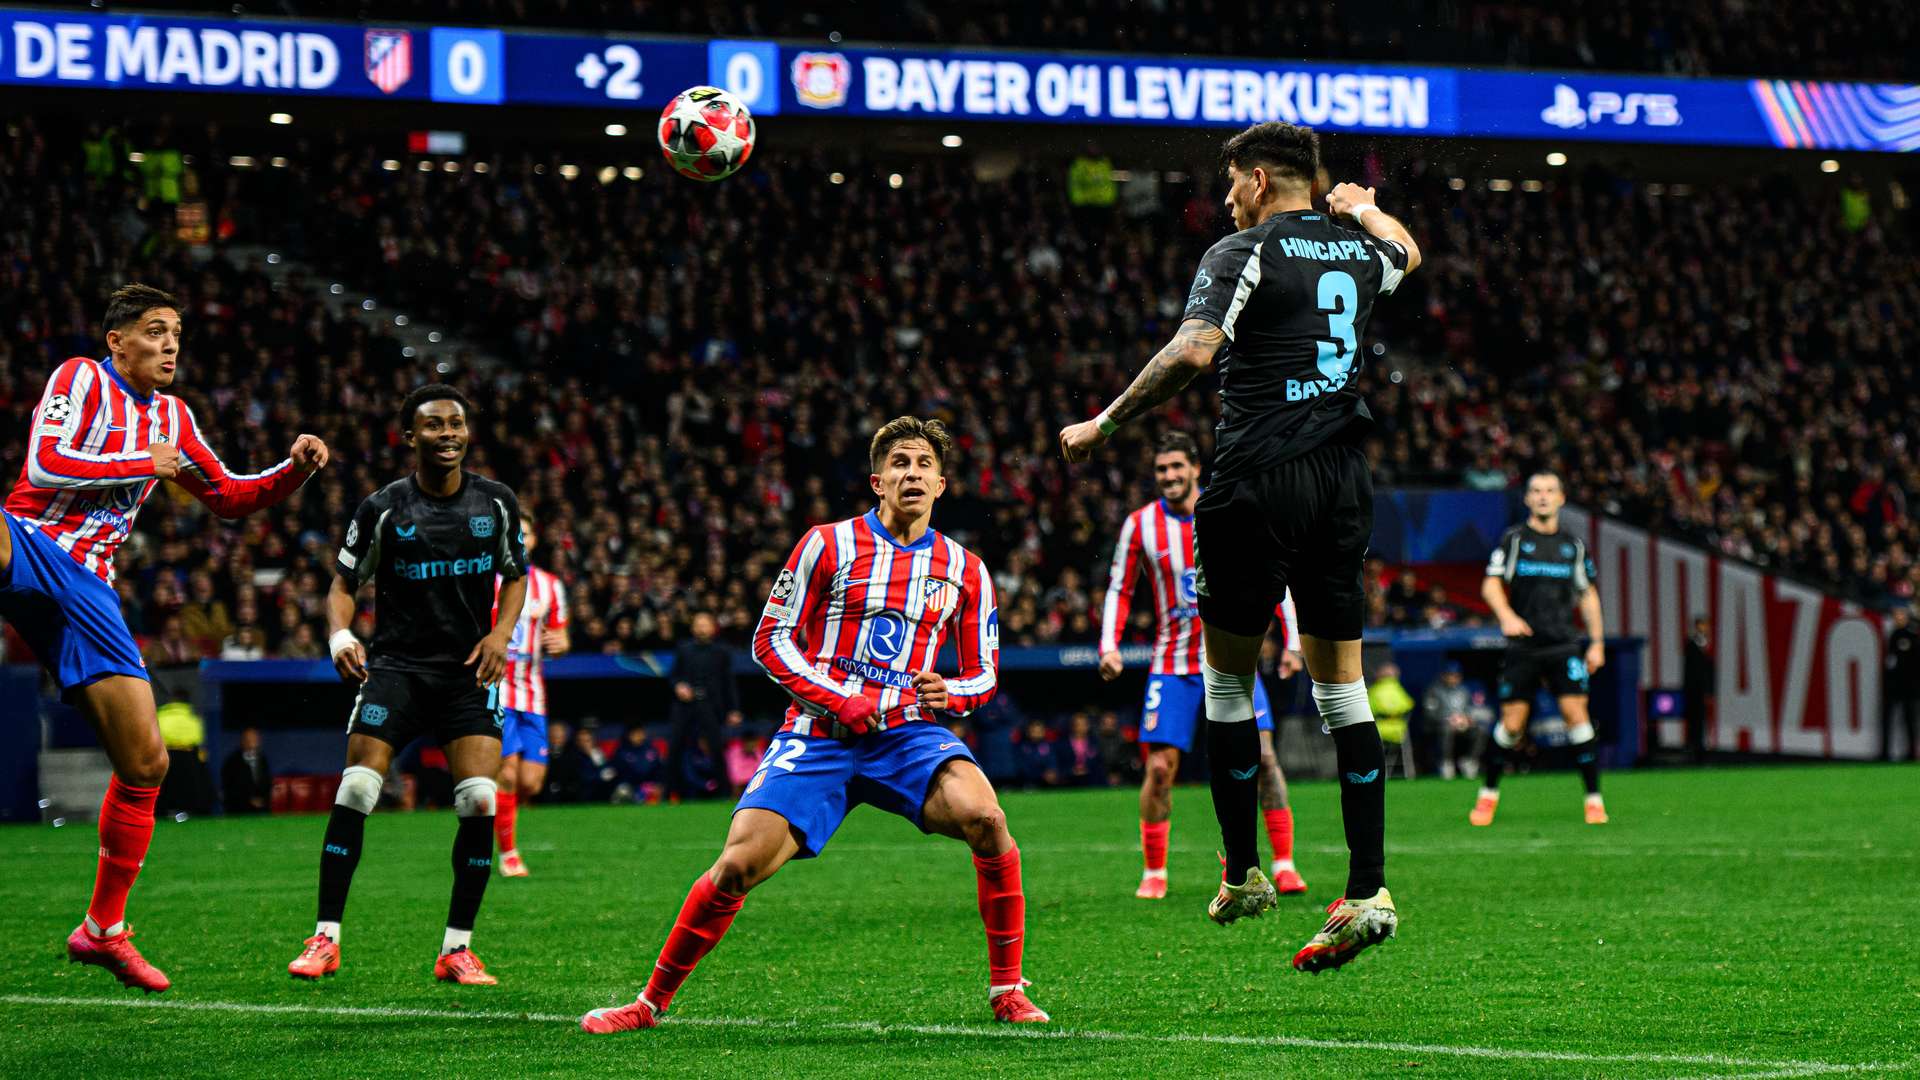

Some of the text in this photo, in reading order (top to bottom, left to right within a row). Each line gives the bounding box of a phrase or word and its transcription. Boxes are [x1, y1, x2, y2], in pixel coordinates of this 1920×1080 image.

[14, 20, 340, 90] DE MADRID
[447, 39, 487, 95] 0
[576, 45, 642, 99] +2
[726, 52, 764, 103] 0
[864, 57, 1429, 129] BAYER 04 LEVERKUSEN
[1588, 91, 1680, 126] PS5
[1279, 236, 1371, 263] HINCAPIE
[1316, 270, 1358, 377] 3
[394, 551, 493, 581] Barmenia
[838, 658, 914, 689] RIYADH AIR
[1145, 681, 1163, 710] 5
[756, 738, 807, 772] 22
